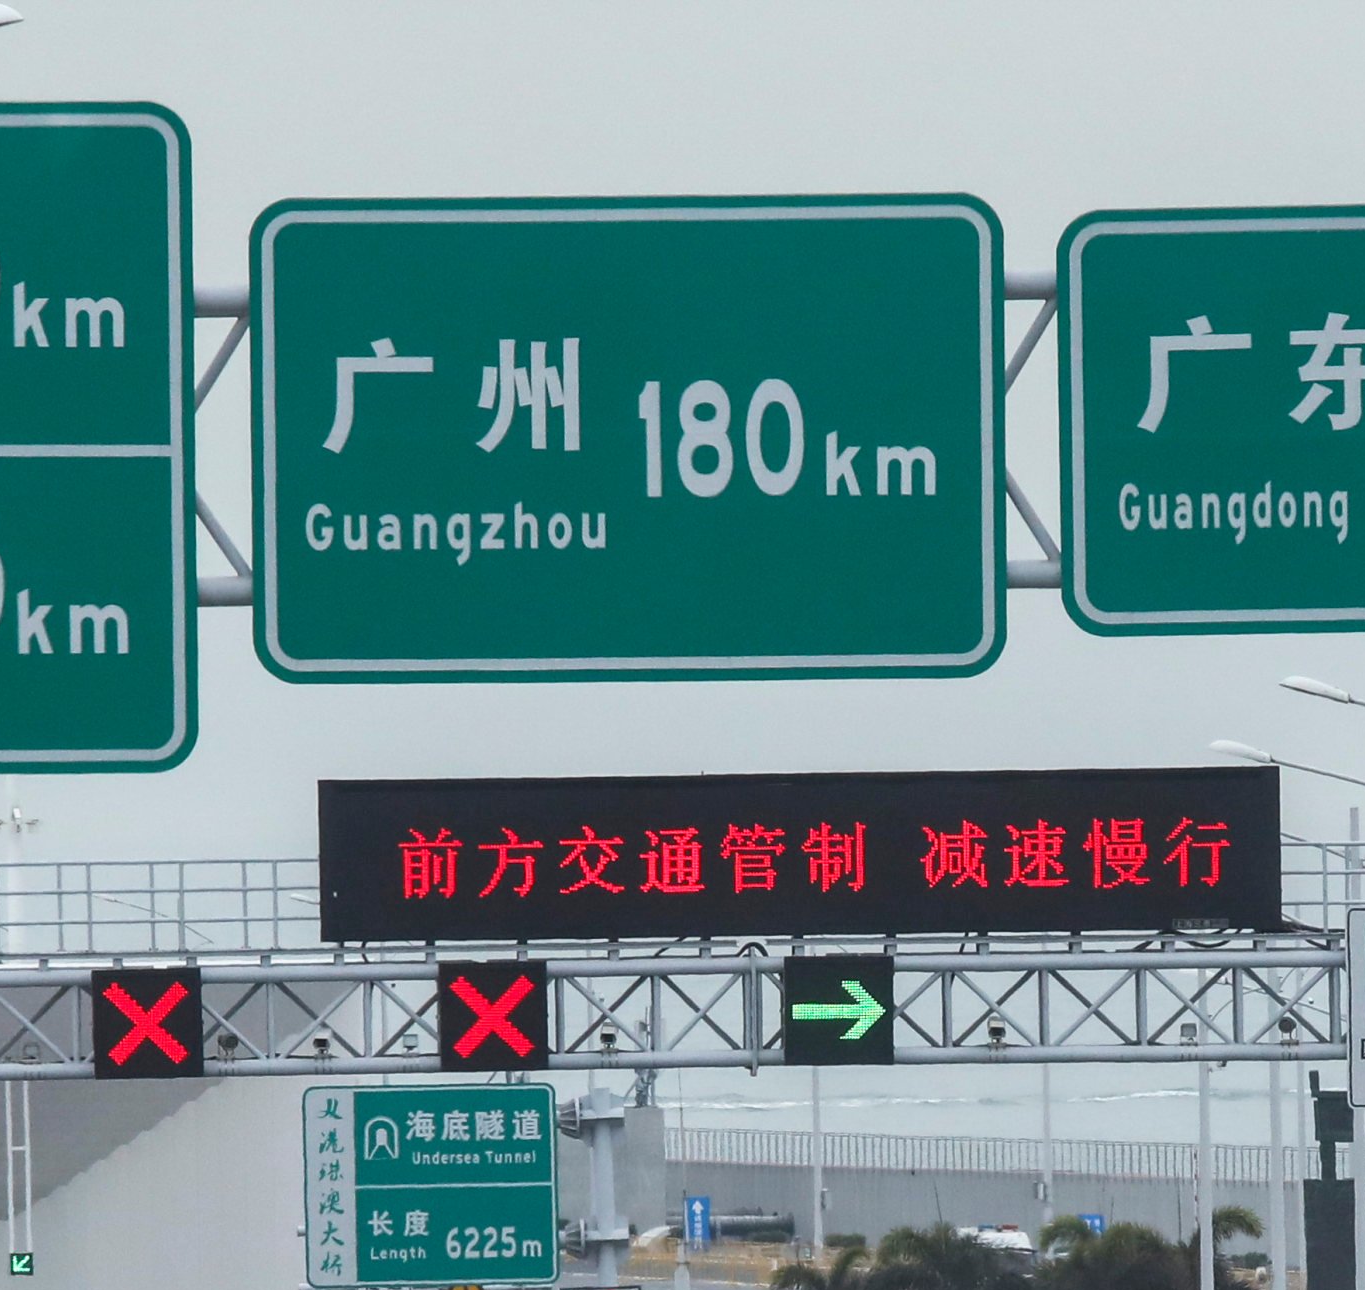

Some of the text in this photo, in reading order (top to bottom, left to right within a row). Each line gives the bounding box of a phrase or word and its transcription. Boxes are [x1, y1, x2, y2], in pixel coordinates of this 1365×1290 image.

[322, 337, 581, 454] 广州
[304, 501, 608, 566] Guangzhou
[1118, 480, 1349, 545] Guangdong
[398, 814, 1231, 901] 前方交通管制 减速慢行
[405, 1109, 542, 1142] 海底隧道
[412, 1150, 536, 1166] Undersea Tunnel
[367, 1209, 430, 1238] 长度
[370, 1246, 427, 1263] Length
